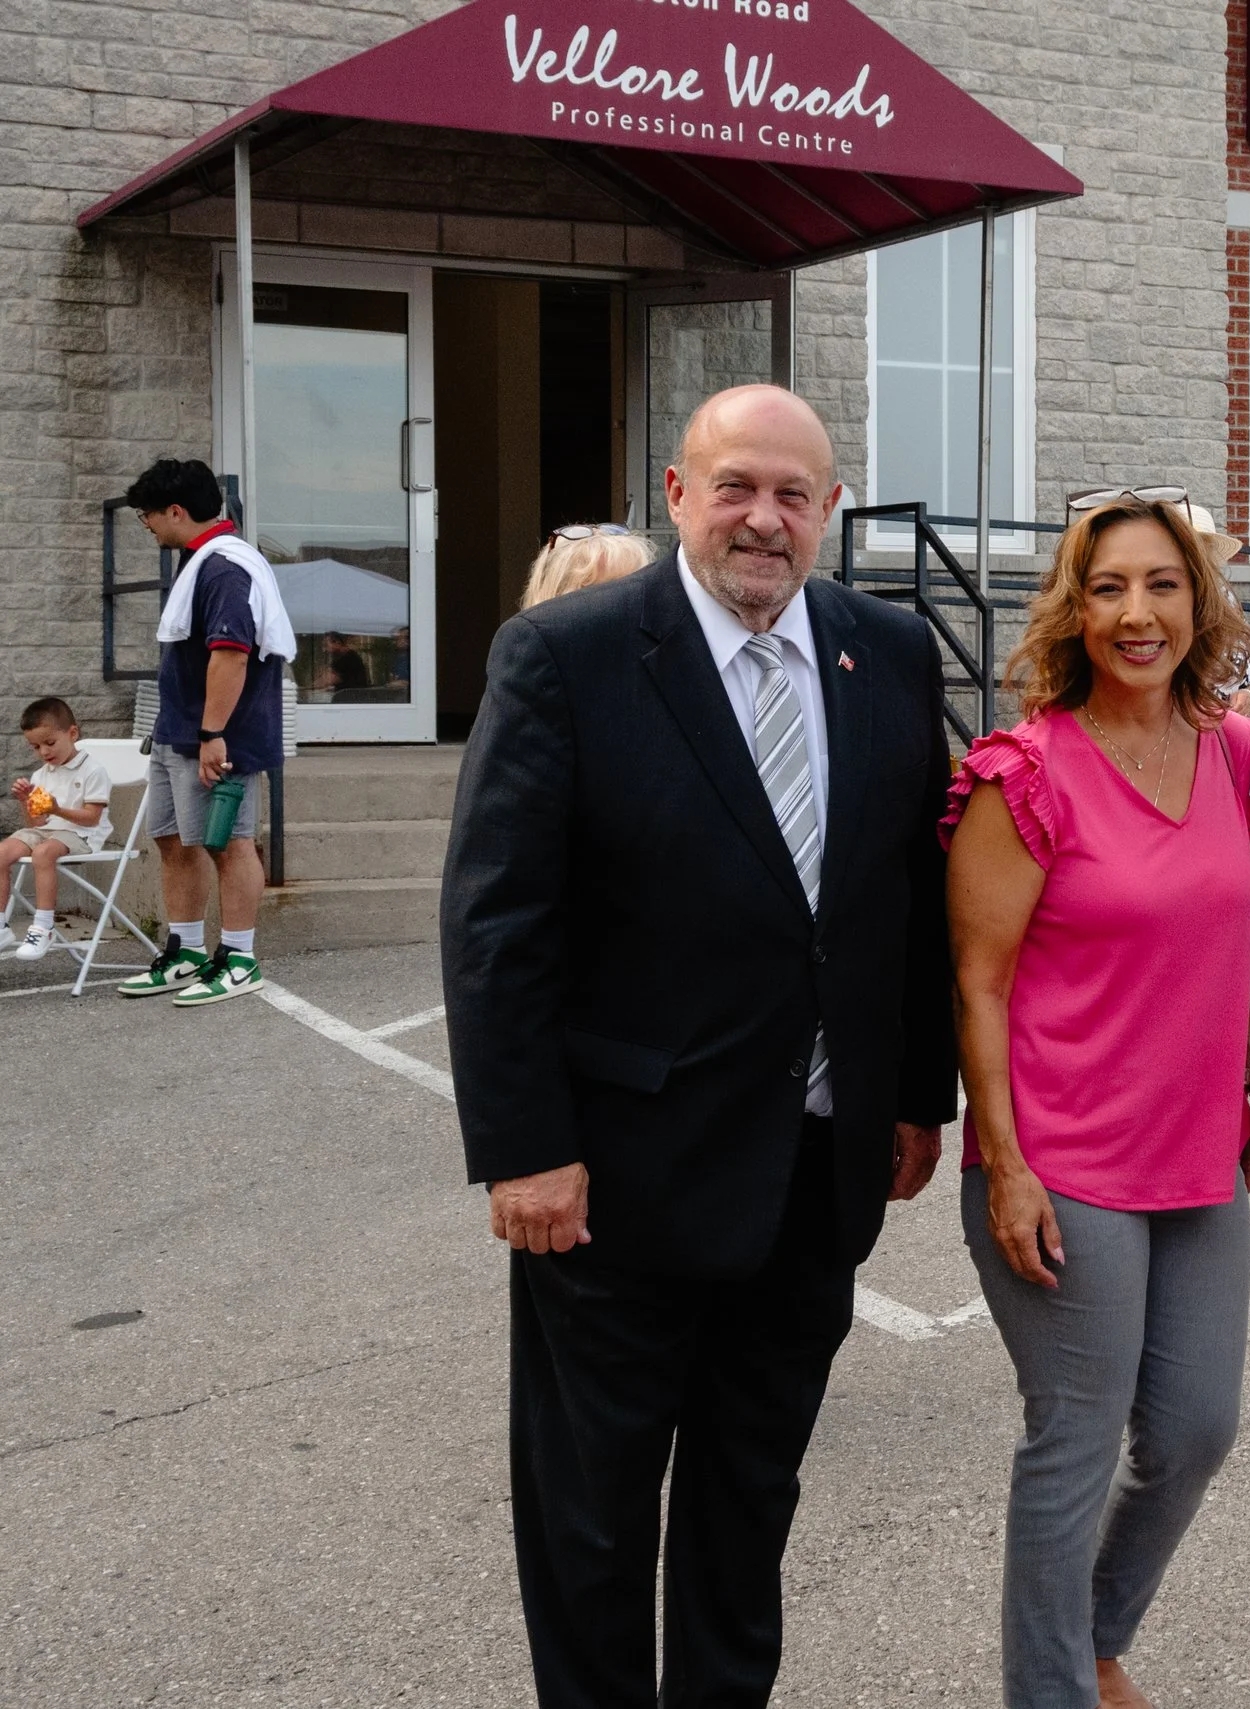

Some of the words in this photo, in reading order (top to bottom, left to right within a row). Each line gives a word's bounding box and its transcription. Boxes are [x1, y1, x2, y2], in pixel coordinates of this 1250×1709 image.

[735, 0, 809, 22] Road
[504, 14, 704, 101] Vellore
[723, 42, 895, 128] Woods
[551, 102, 745, 143] Professional
[758, 125, 854, 155] Centre
